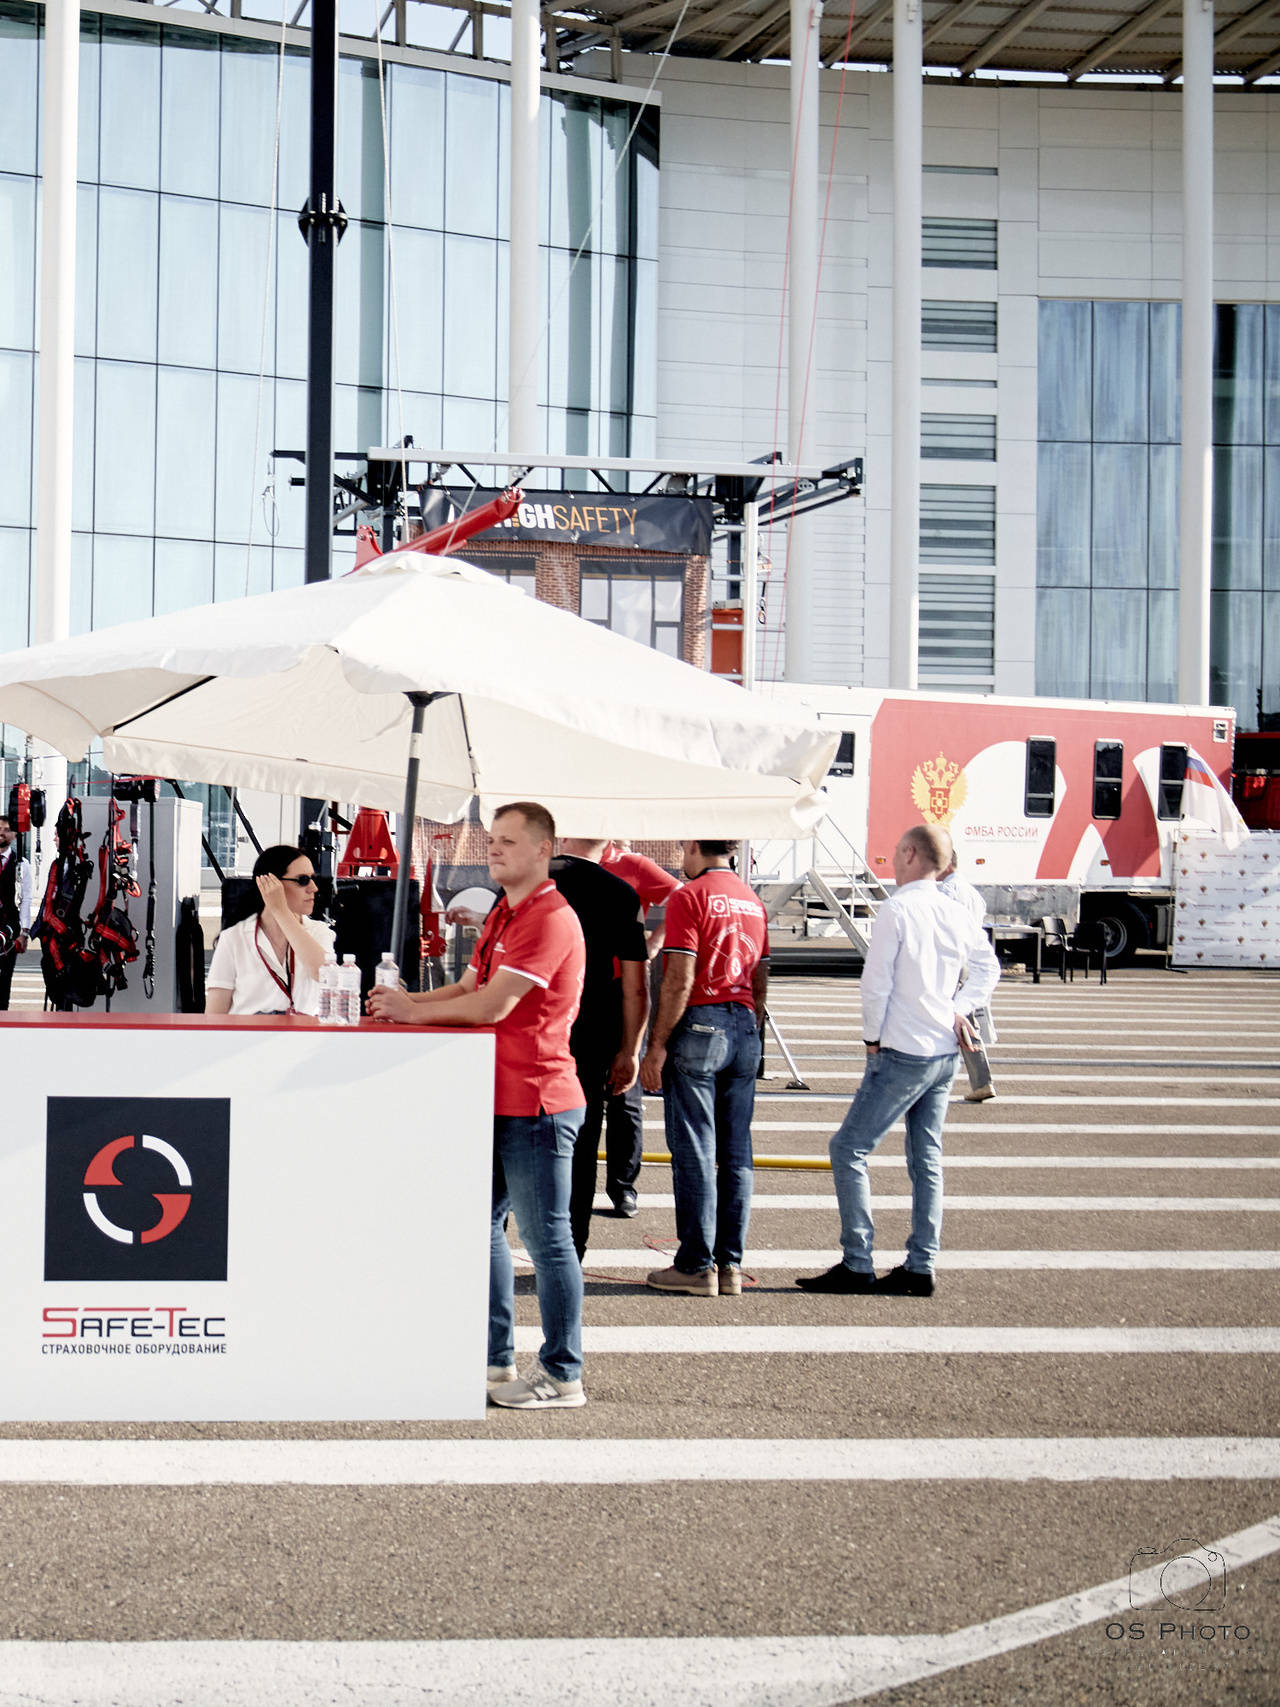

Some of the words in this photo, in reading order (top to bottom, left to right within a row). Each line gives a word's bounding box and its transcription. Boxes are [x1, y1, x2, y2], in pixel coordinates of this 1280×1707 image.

[965, 826, 995, 837] ФМБА
[997, 826, 1039, 838] РОССИИ
[42, 1343, 131, 1355] СТРАХОВОЧНОЕ
[135, 1343, 227, 1356] ОБОРУДОВАНИЕ
